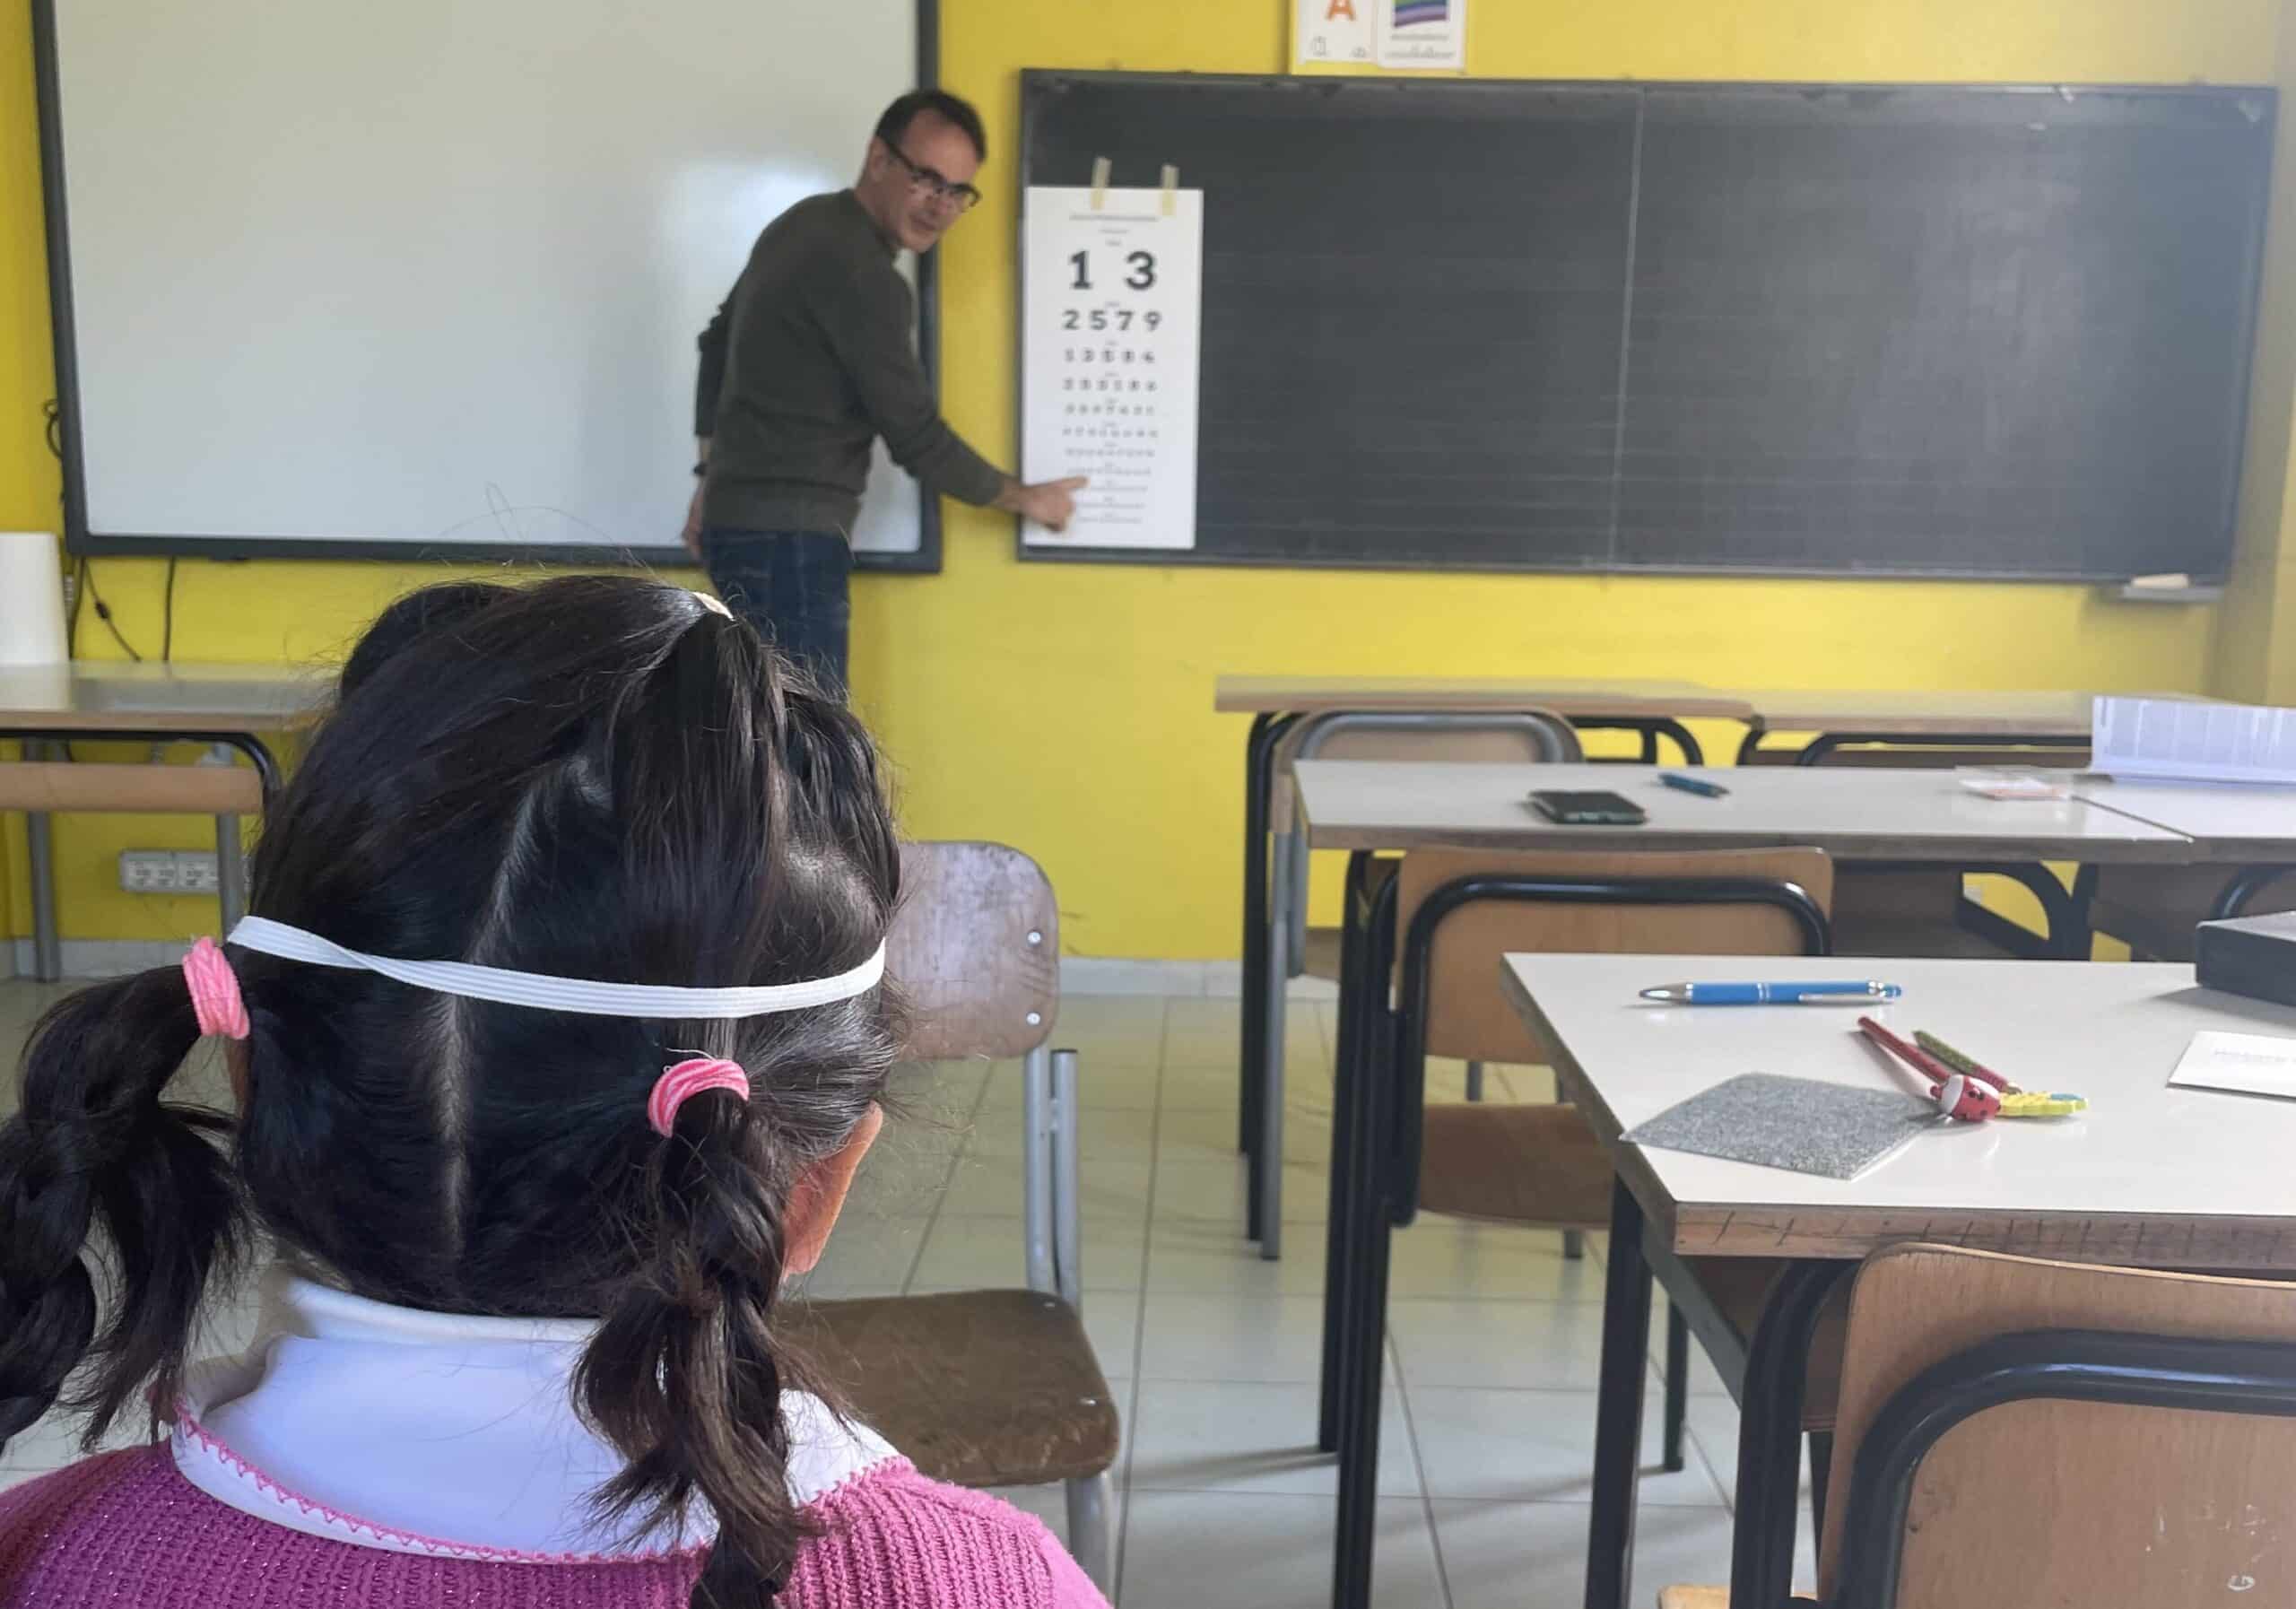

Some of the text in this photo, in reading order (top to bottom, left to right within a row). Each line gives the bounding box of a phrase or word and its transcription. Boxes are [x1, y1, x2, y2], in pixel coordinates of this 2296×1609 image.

[1070, 250, 1157, 291] 1 3
[1064, 309, 1161, 332] 2 5 7 9
